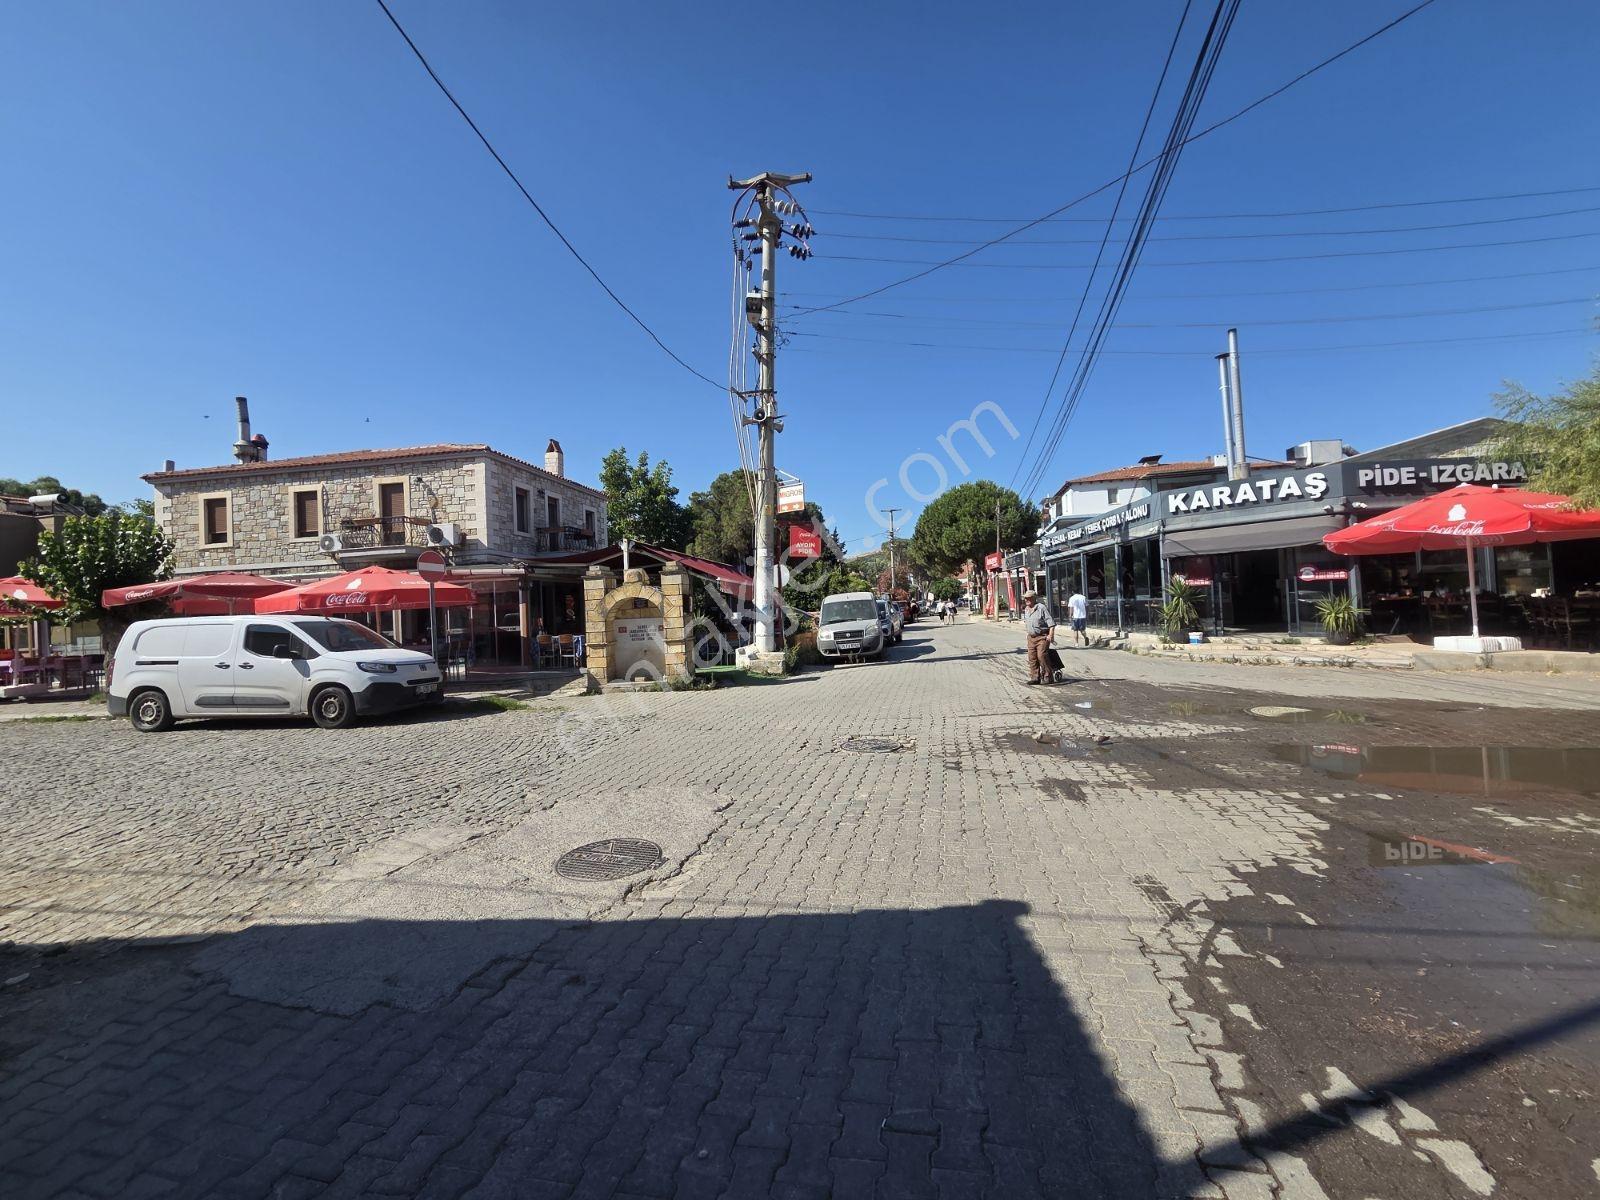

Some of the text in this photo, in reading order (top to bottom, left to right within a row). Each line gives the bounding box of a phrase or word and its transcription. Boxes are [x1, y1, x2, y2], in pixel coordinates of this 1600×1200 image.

[1358, 463, 1416, 487] PİDE
[1431, 461, 1528, 484] IZGARA
[780, 488, 803, 497] MIGROS
[1168, 472, 1327, 513] KARATAŞ
